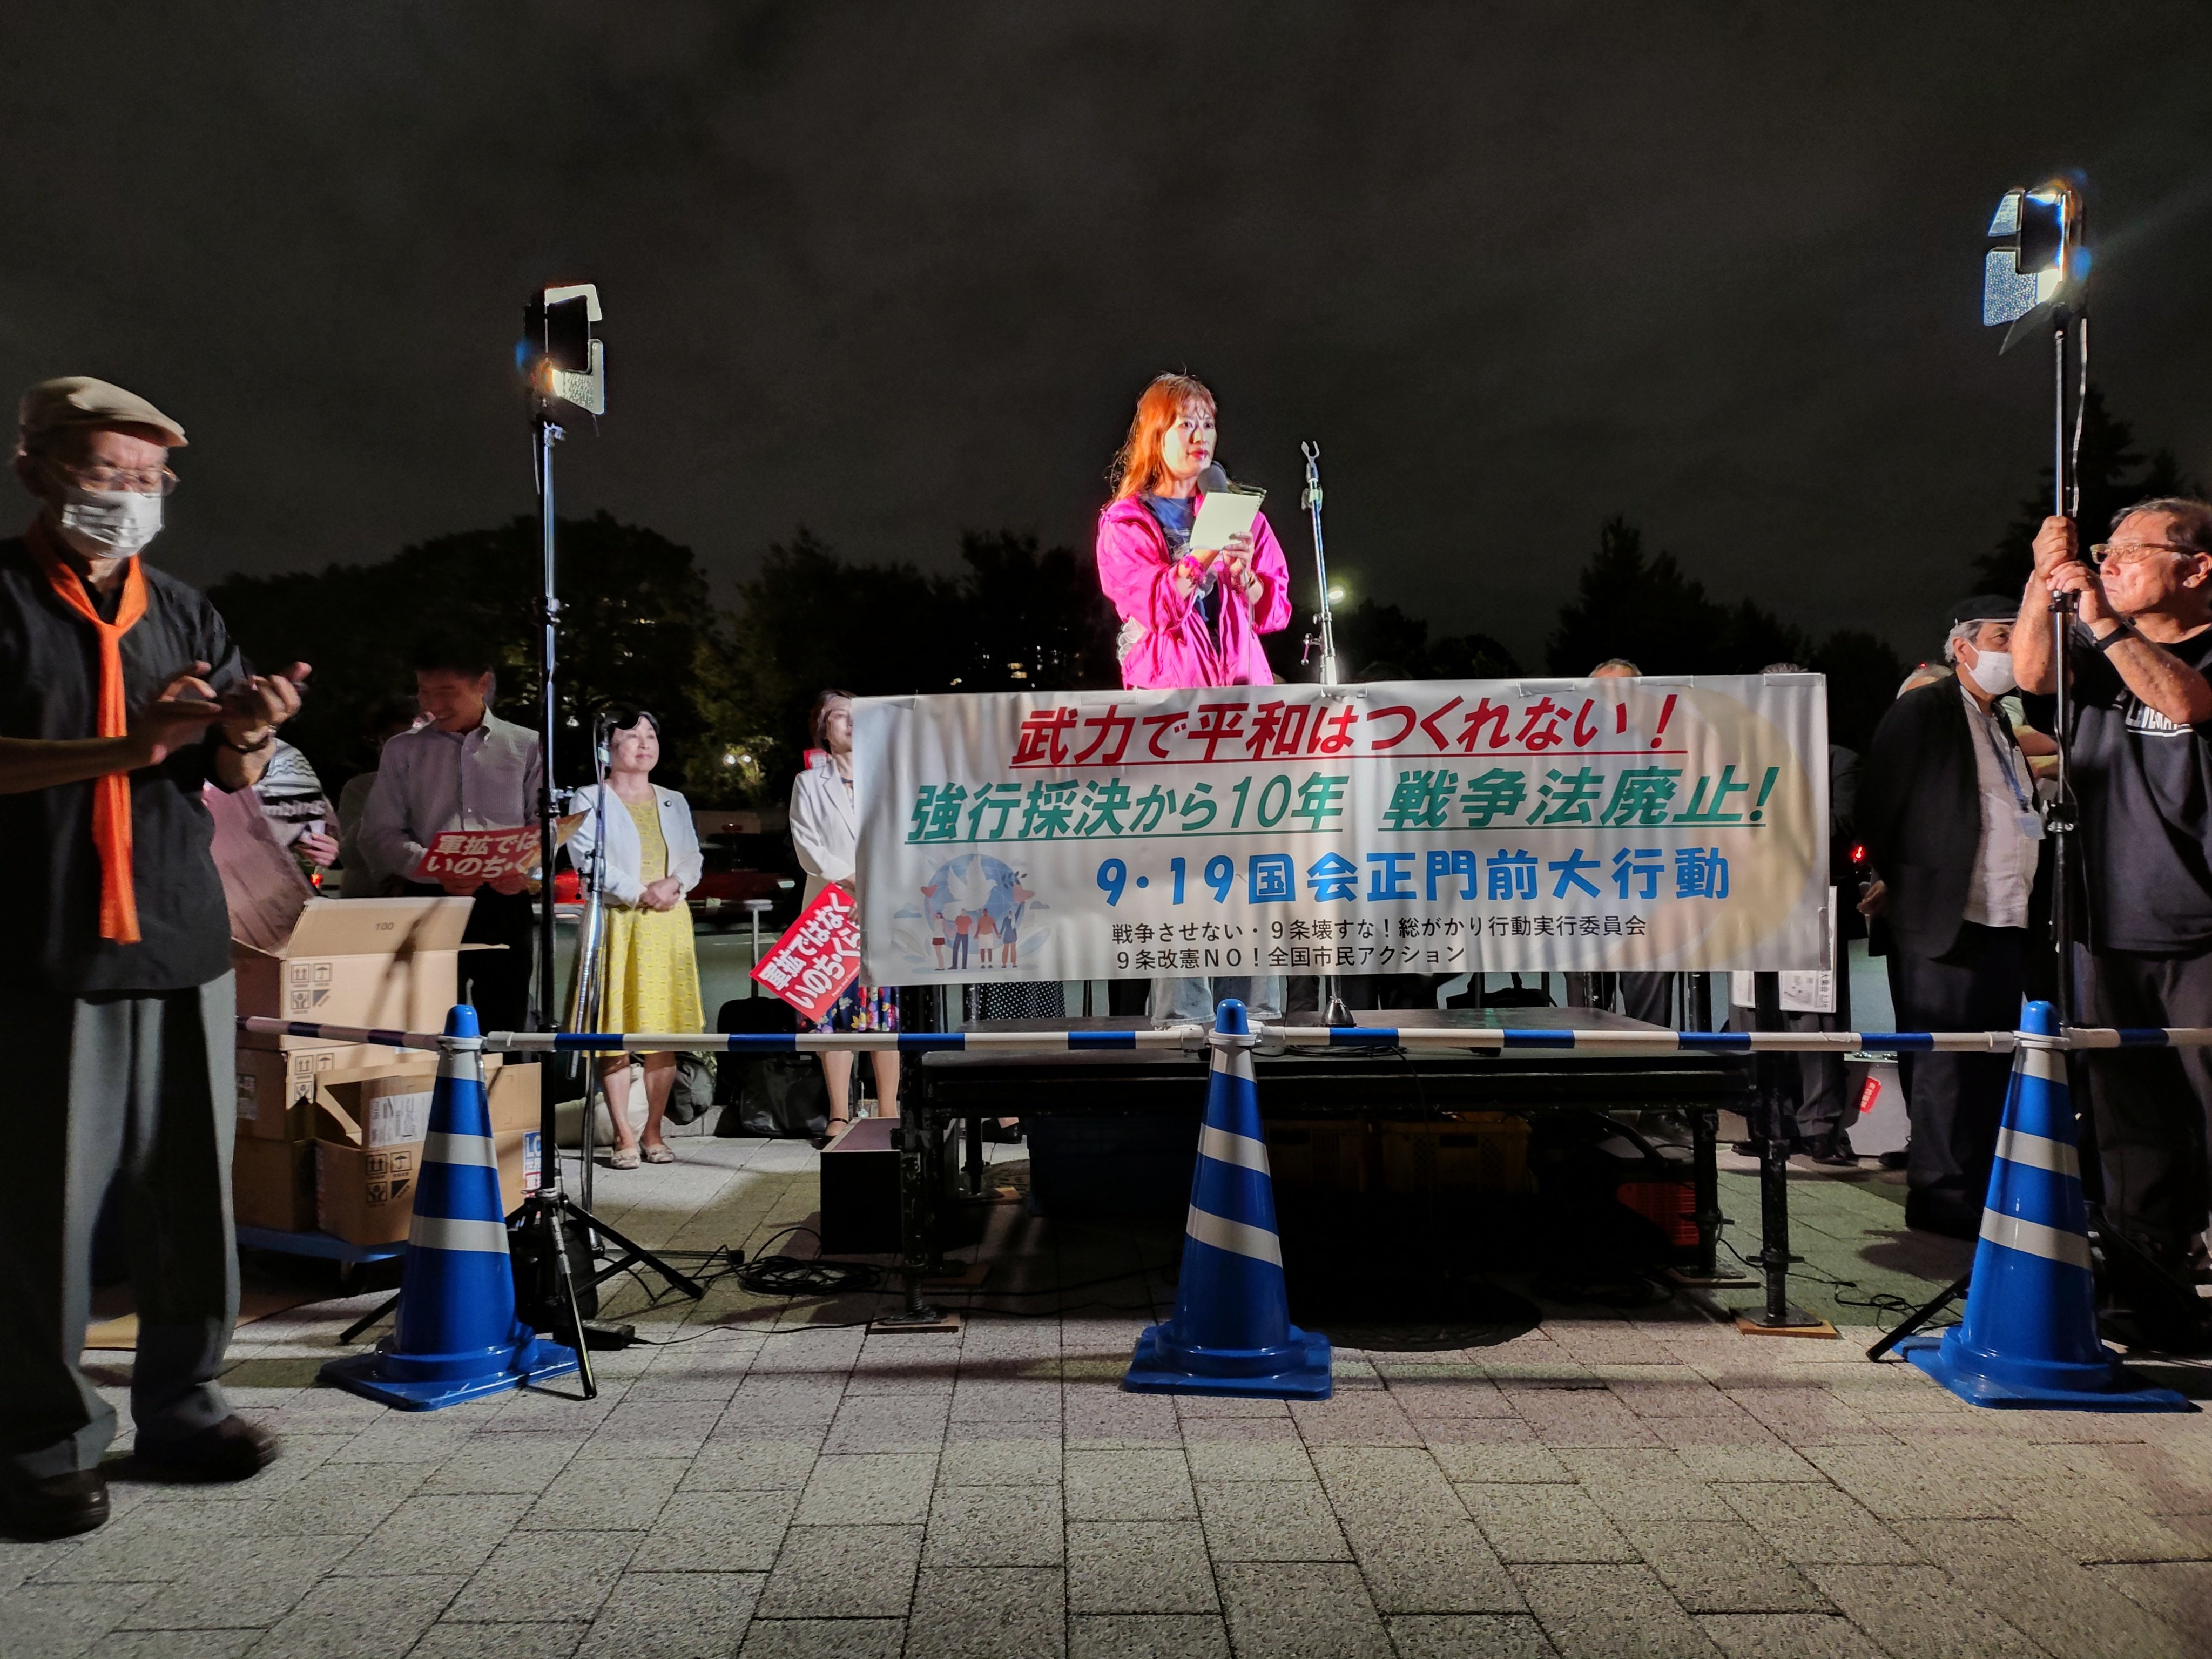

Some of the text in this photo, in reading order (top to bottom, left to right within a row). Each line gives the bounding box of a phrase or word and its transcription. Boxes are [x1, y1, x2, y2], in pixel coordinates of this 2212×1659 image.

[1012, 694, 1678, 765] 武力で平和はつくれない！
[908, 765, 1779, 841] 強行採決から10年 戦争法廃止!
[1097, 847, 1730, 905] 9・19国会正門前大行動
[375, 922, 395, 931] 100
[758, 892, 851, 992] 軍拡ではなく
[1116, 945, 1465, 970] 9条改憲NO！全国市民アクション
